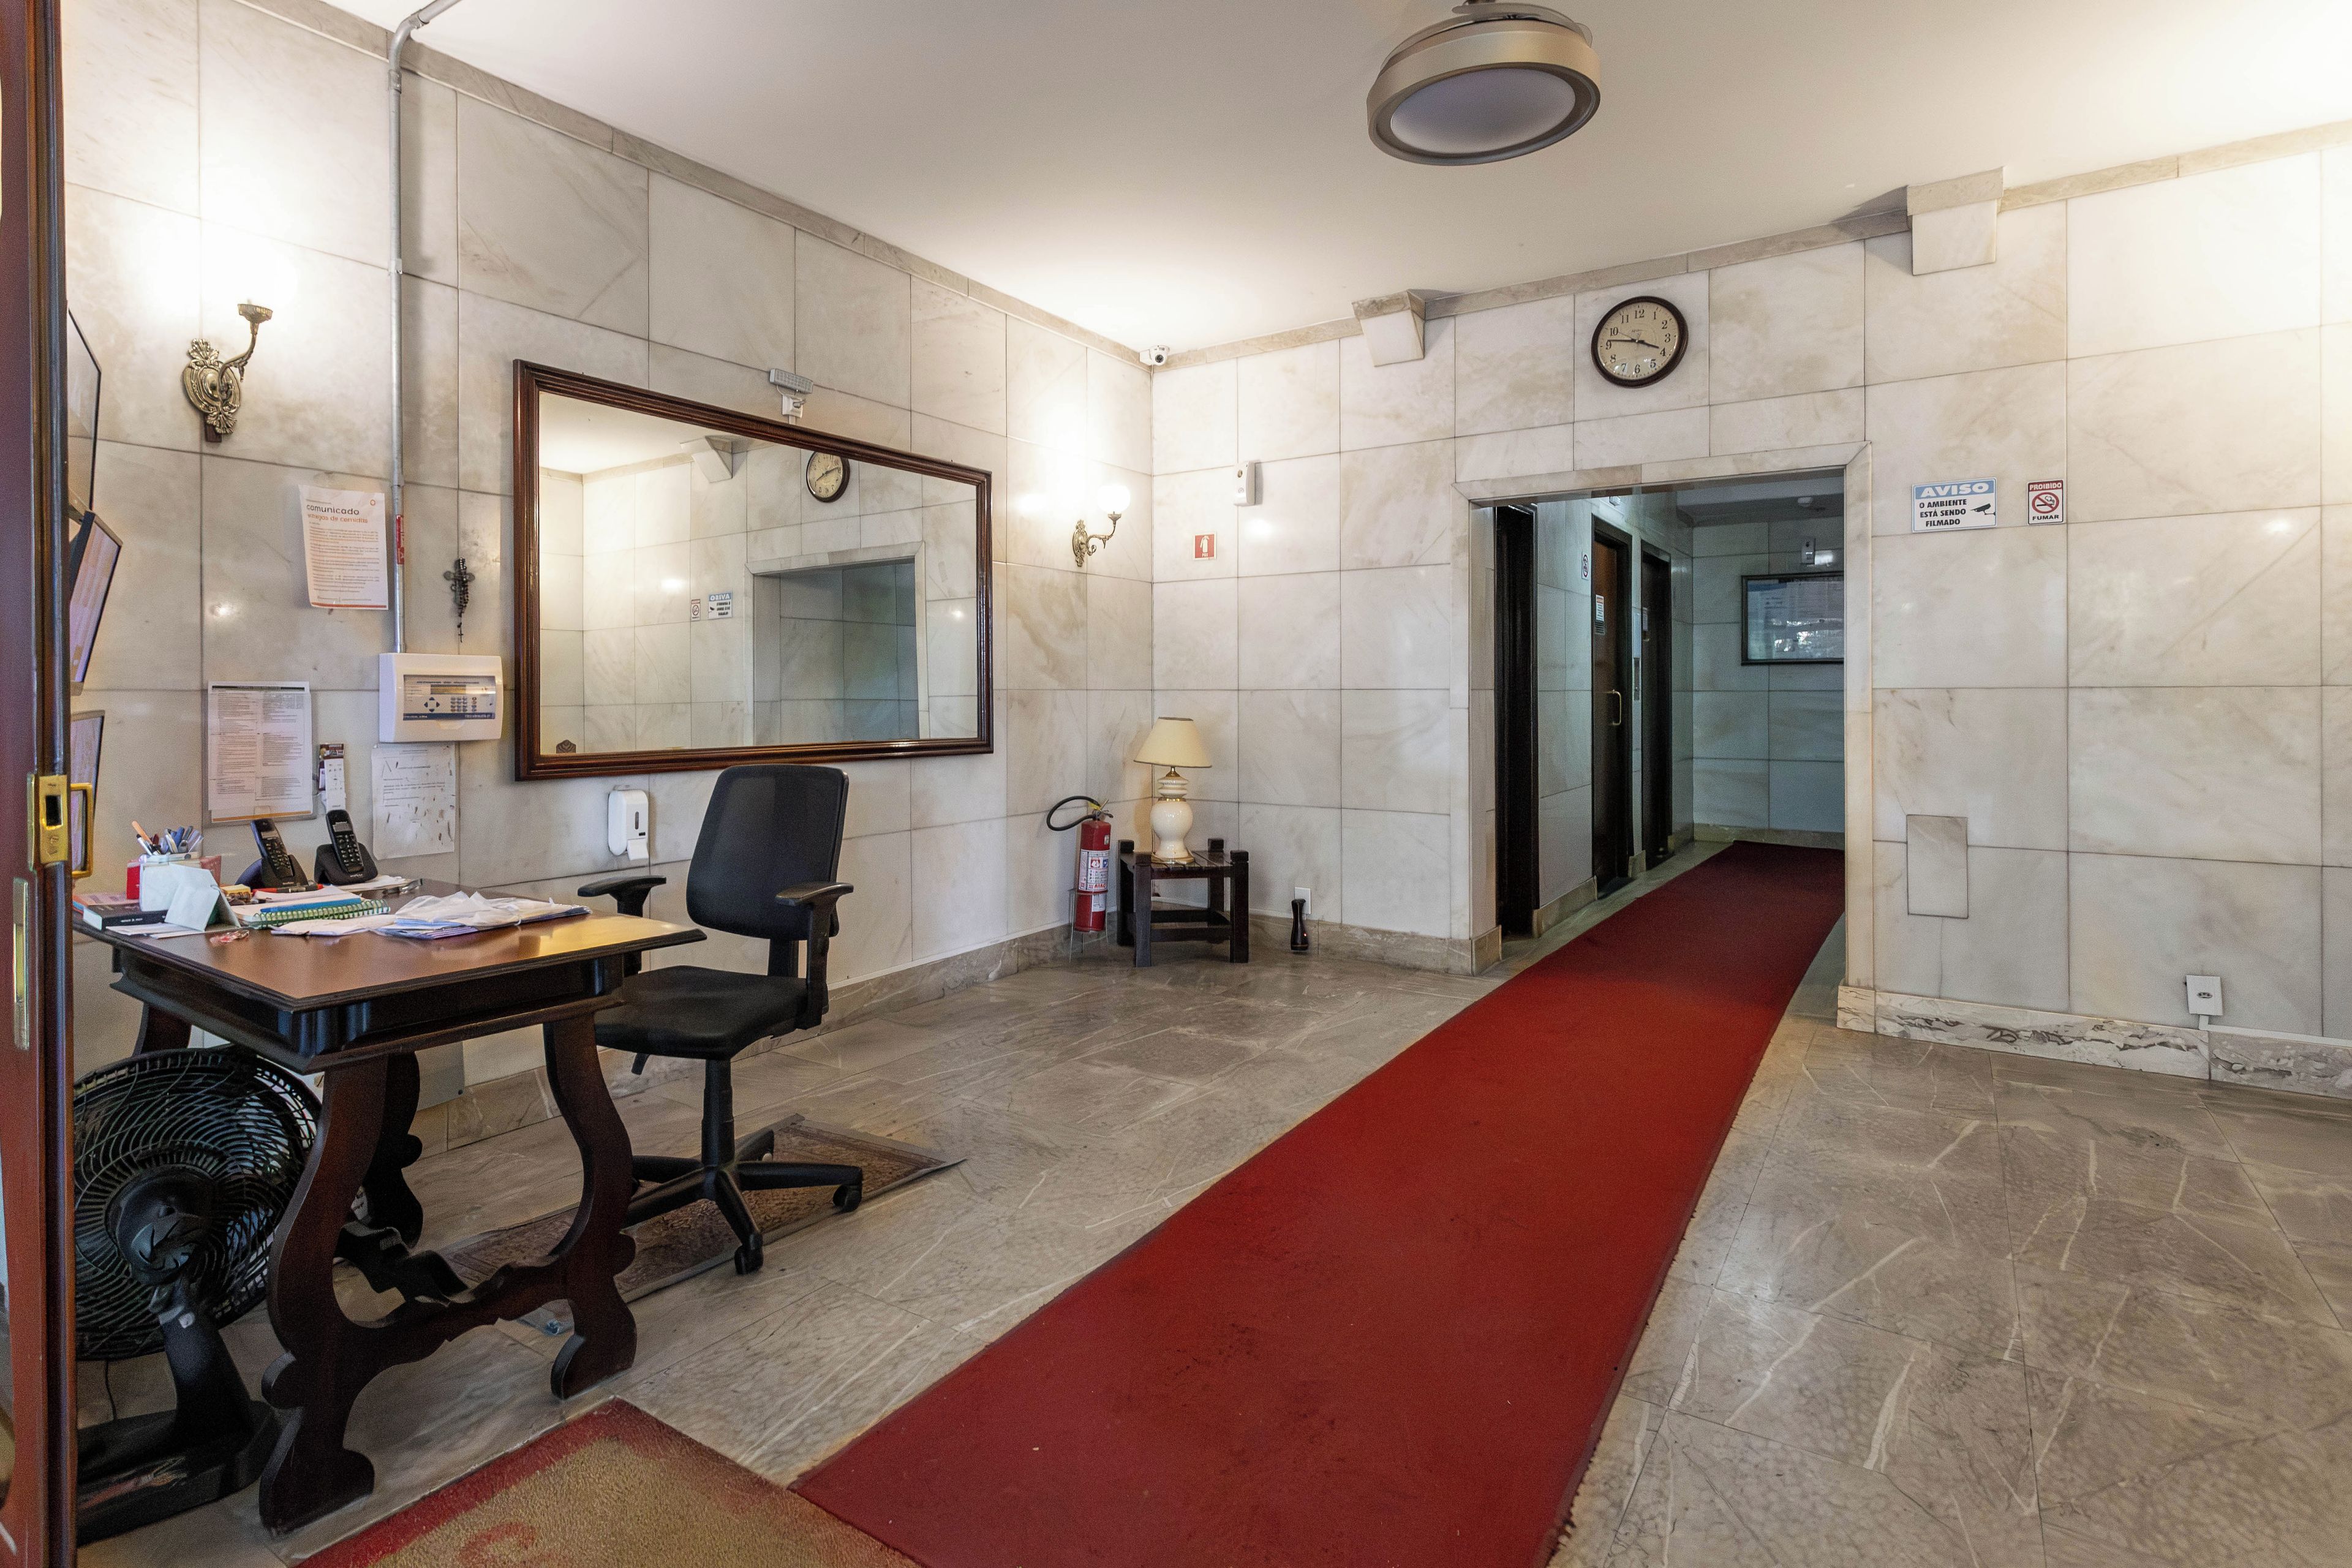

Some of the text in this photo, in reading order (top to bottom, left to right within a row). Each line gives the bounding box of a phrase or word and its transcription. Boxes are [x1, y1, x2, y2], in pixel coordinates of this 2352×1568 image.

[1635, 309, 1645, 318] 12
[1621, 314, 1629, 324] 11
[1662, 320, 1668, 330] 2
[1610, 326, 1618, 336] 10
[1664, 333, 1671, 343] 3
[1605, 339, 1612, 350] 9
[1660, 347, 1666, 356] 4
[1610, 354, 1616, 363] 8
[1650, 358, 1656, 368] 5
[1621, 363, 1627, 372] 7
[1634, 364, 1640, 374] 6
[1920, 482, 1989, 498] AVISO
[2029, 482, 2062, 491] PROIBIDO
[1927, 499, 1967, 508] AMBIENTE
[306, 504, 360, 515] comunicado
[1920, 509, 1938, 518] ESTÁ
